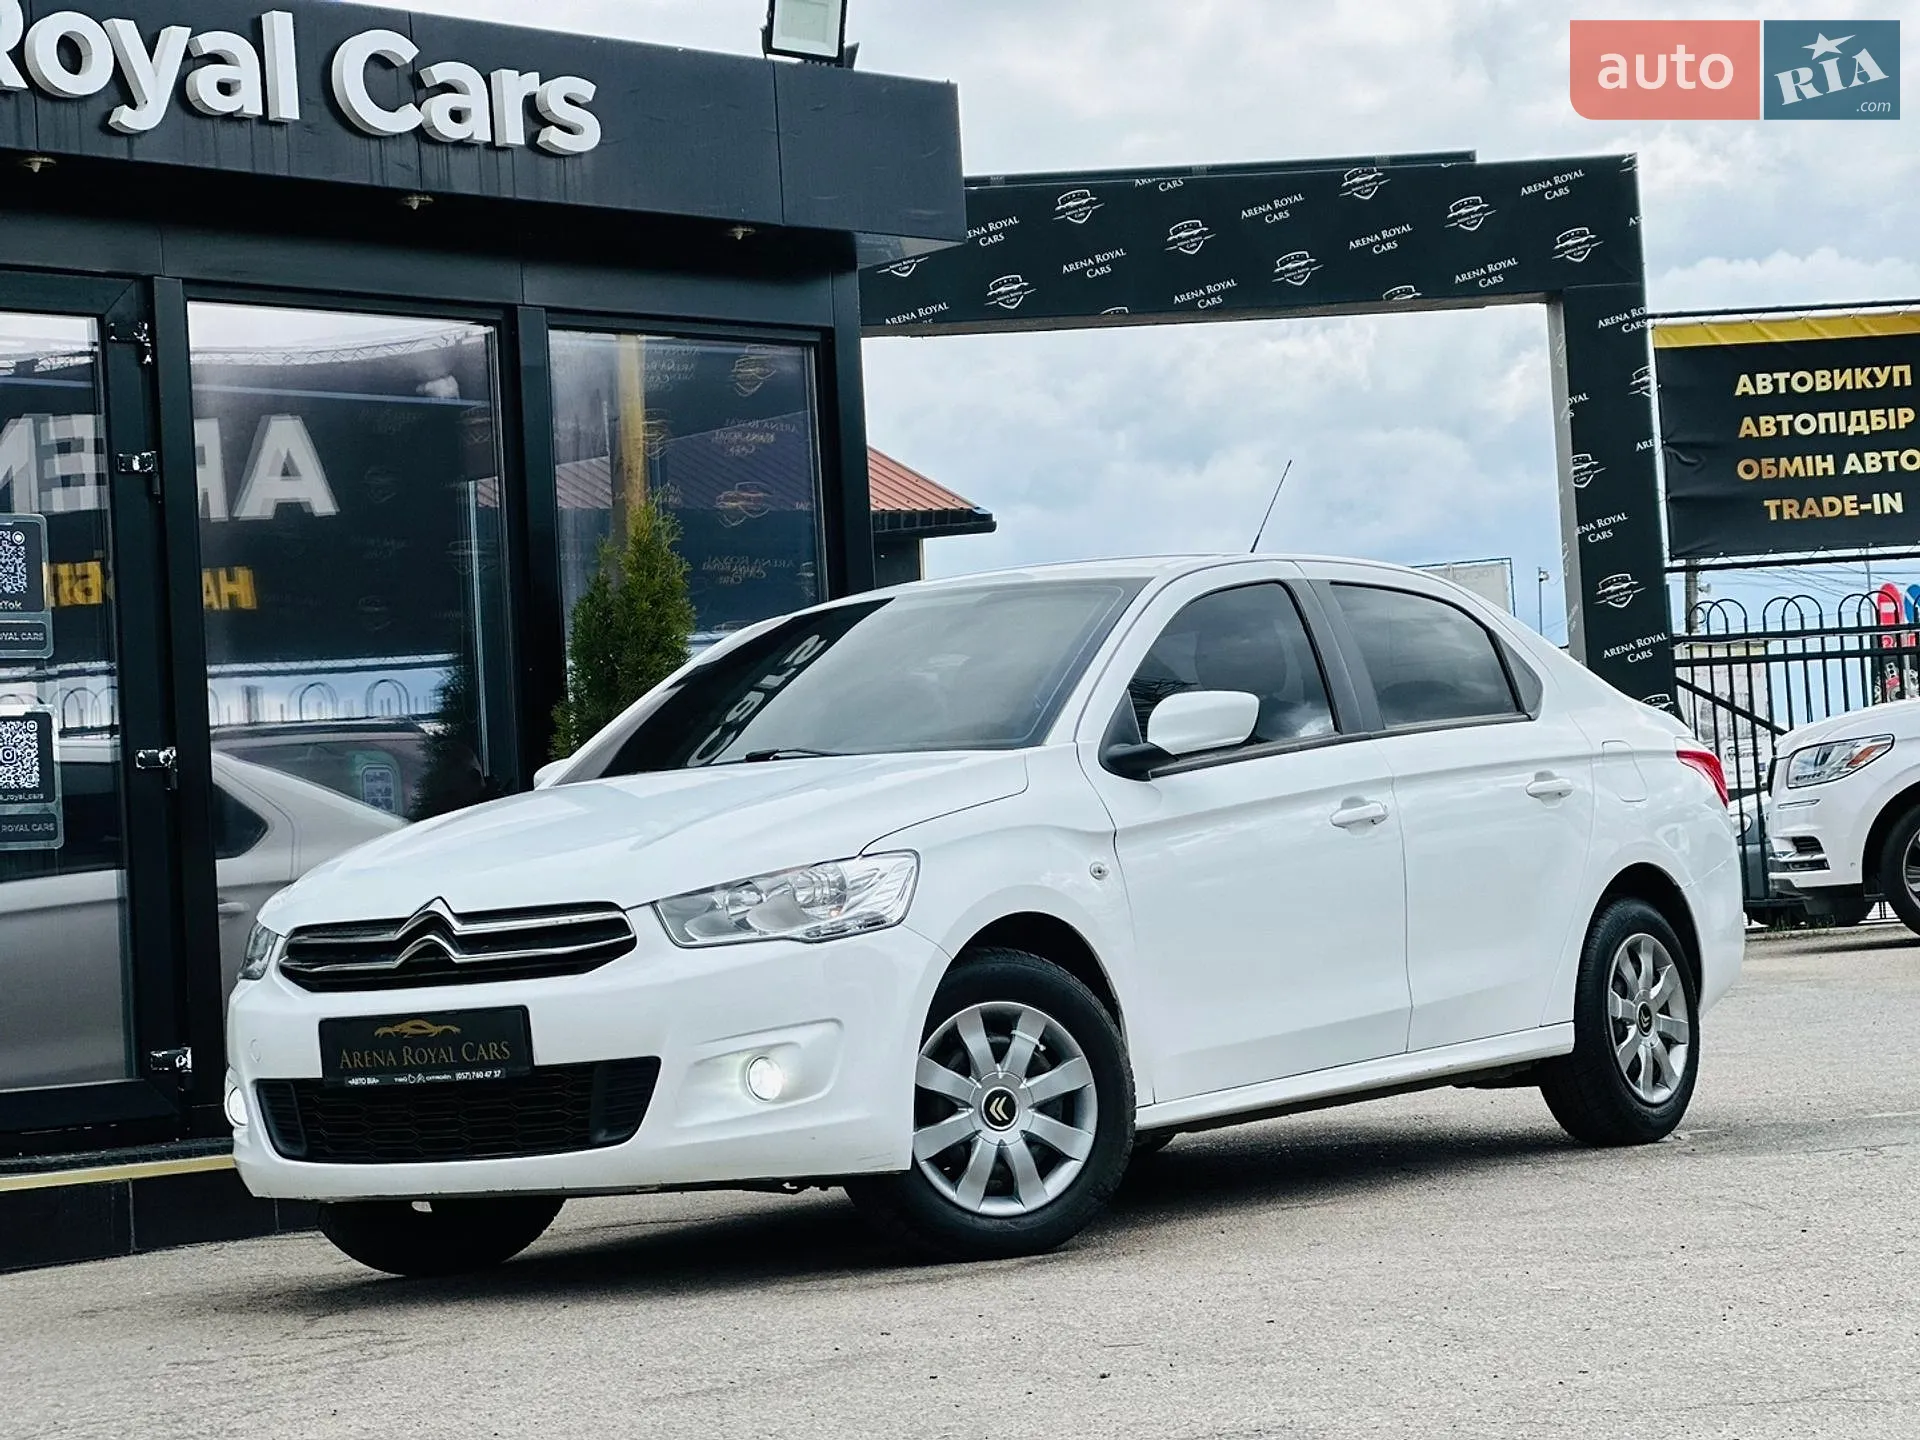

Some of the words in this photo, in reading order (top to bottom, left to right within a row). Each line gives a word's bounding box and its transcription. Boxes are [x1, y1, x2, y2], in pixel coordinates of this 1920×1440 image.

[331, 28, 601, 155] Cars
[1158, 178, 1184, 192] CARS
[1521, 179, 1553, 196] ARENA
[1553, 169, 1585, 185] ROYAL
[1544, 186, 1570, 200] CARS
[1241, 203, 1273, 220] ARENA
[1273, 193, 1305, 209] ROYAL
[1265, 209, 1290, 224] CARS
[967, 226, 988, 239] ENA
[988, 216, 1020, 231] ROYAL
[1349, 233, 1380, 250] ARENA
[1381, 223, 1413, 240] ROYAL
[979, 232, 1005, 247] CARS
[1372, 240, 1398, 254] CARS
[1062, 257, 1094, 275] ARENA
[1095, 248, 1127, 265] ROYAL
[1086, 264, 1112, 279] CARS
[1454, 267, 1486, 284] ARENA
[1487, 257, 1519, 273] ROYAL
[1173, 288, 1205, 304] ARENA
[1206, 278, 1238, 294] ROYAL
[1478, 273, 1504, 288] CARS
[918, 301, 950, 318] ROYAL
[1197, 295, 1223, 309] CARS
[1598, 312, 1630, 328] ARENA
[1734, 364, 1912, 396] АВТОВИКУП
[1738, 407, 1915, 438] АВТОПІДБІР
[1736, 454, 1835, 481] ОБМІН
[1843, 449, 1920, 475] АВТО
[1763, 492, 1904, 521] TRADE-IN
[1576, 522, 1596, 535] ENA
[1596, 512, 1629, 528] ROYAL
[1587, 529, 1613, 543] CARS
[1602, 642, 1634, 659] ARENA
[1636, 632, 1668, 648] ROYAL
[1627, 649, 1653, 663] CARS
[340, 1050, 397, 1070] ARENA
[402, 1045, 457, 1066] ROYAL
[461, 1040, 511, 1061] CARS
